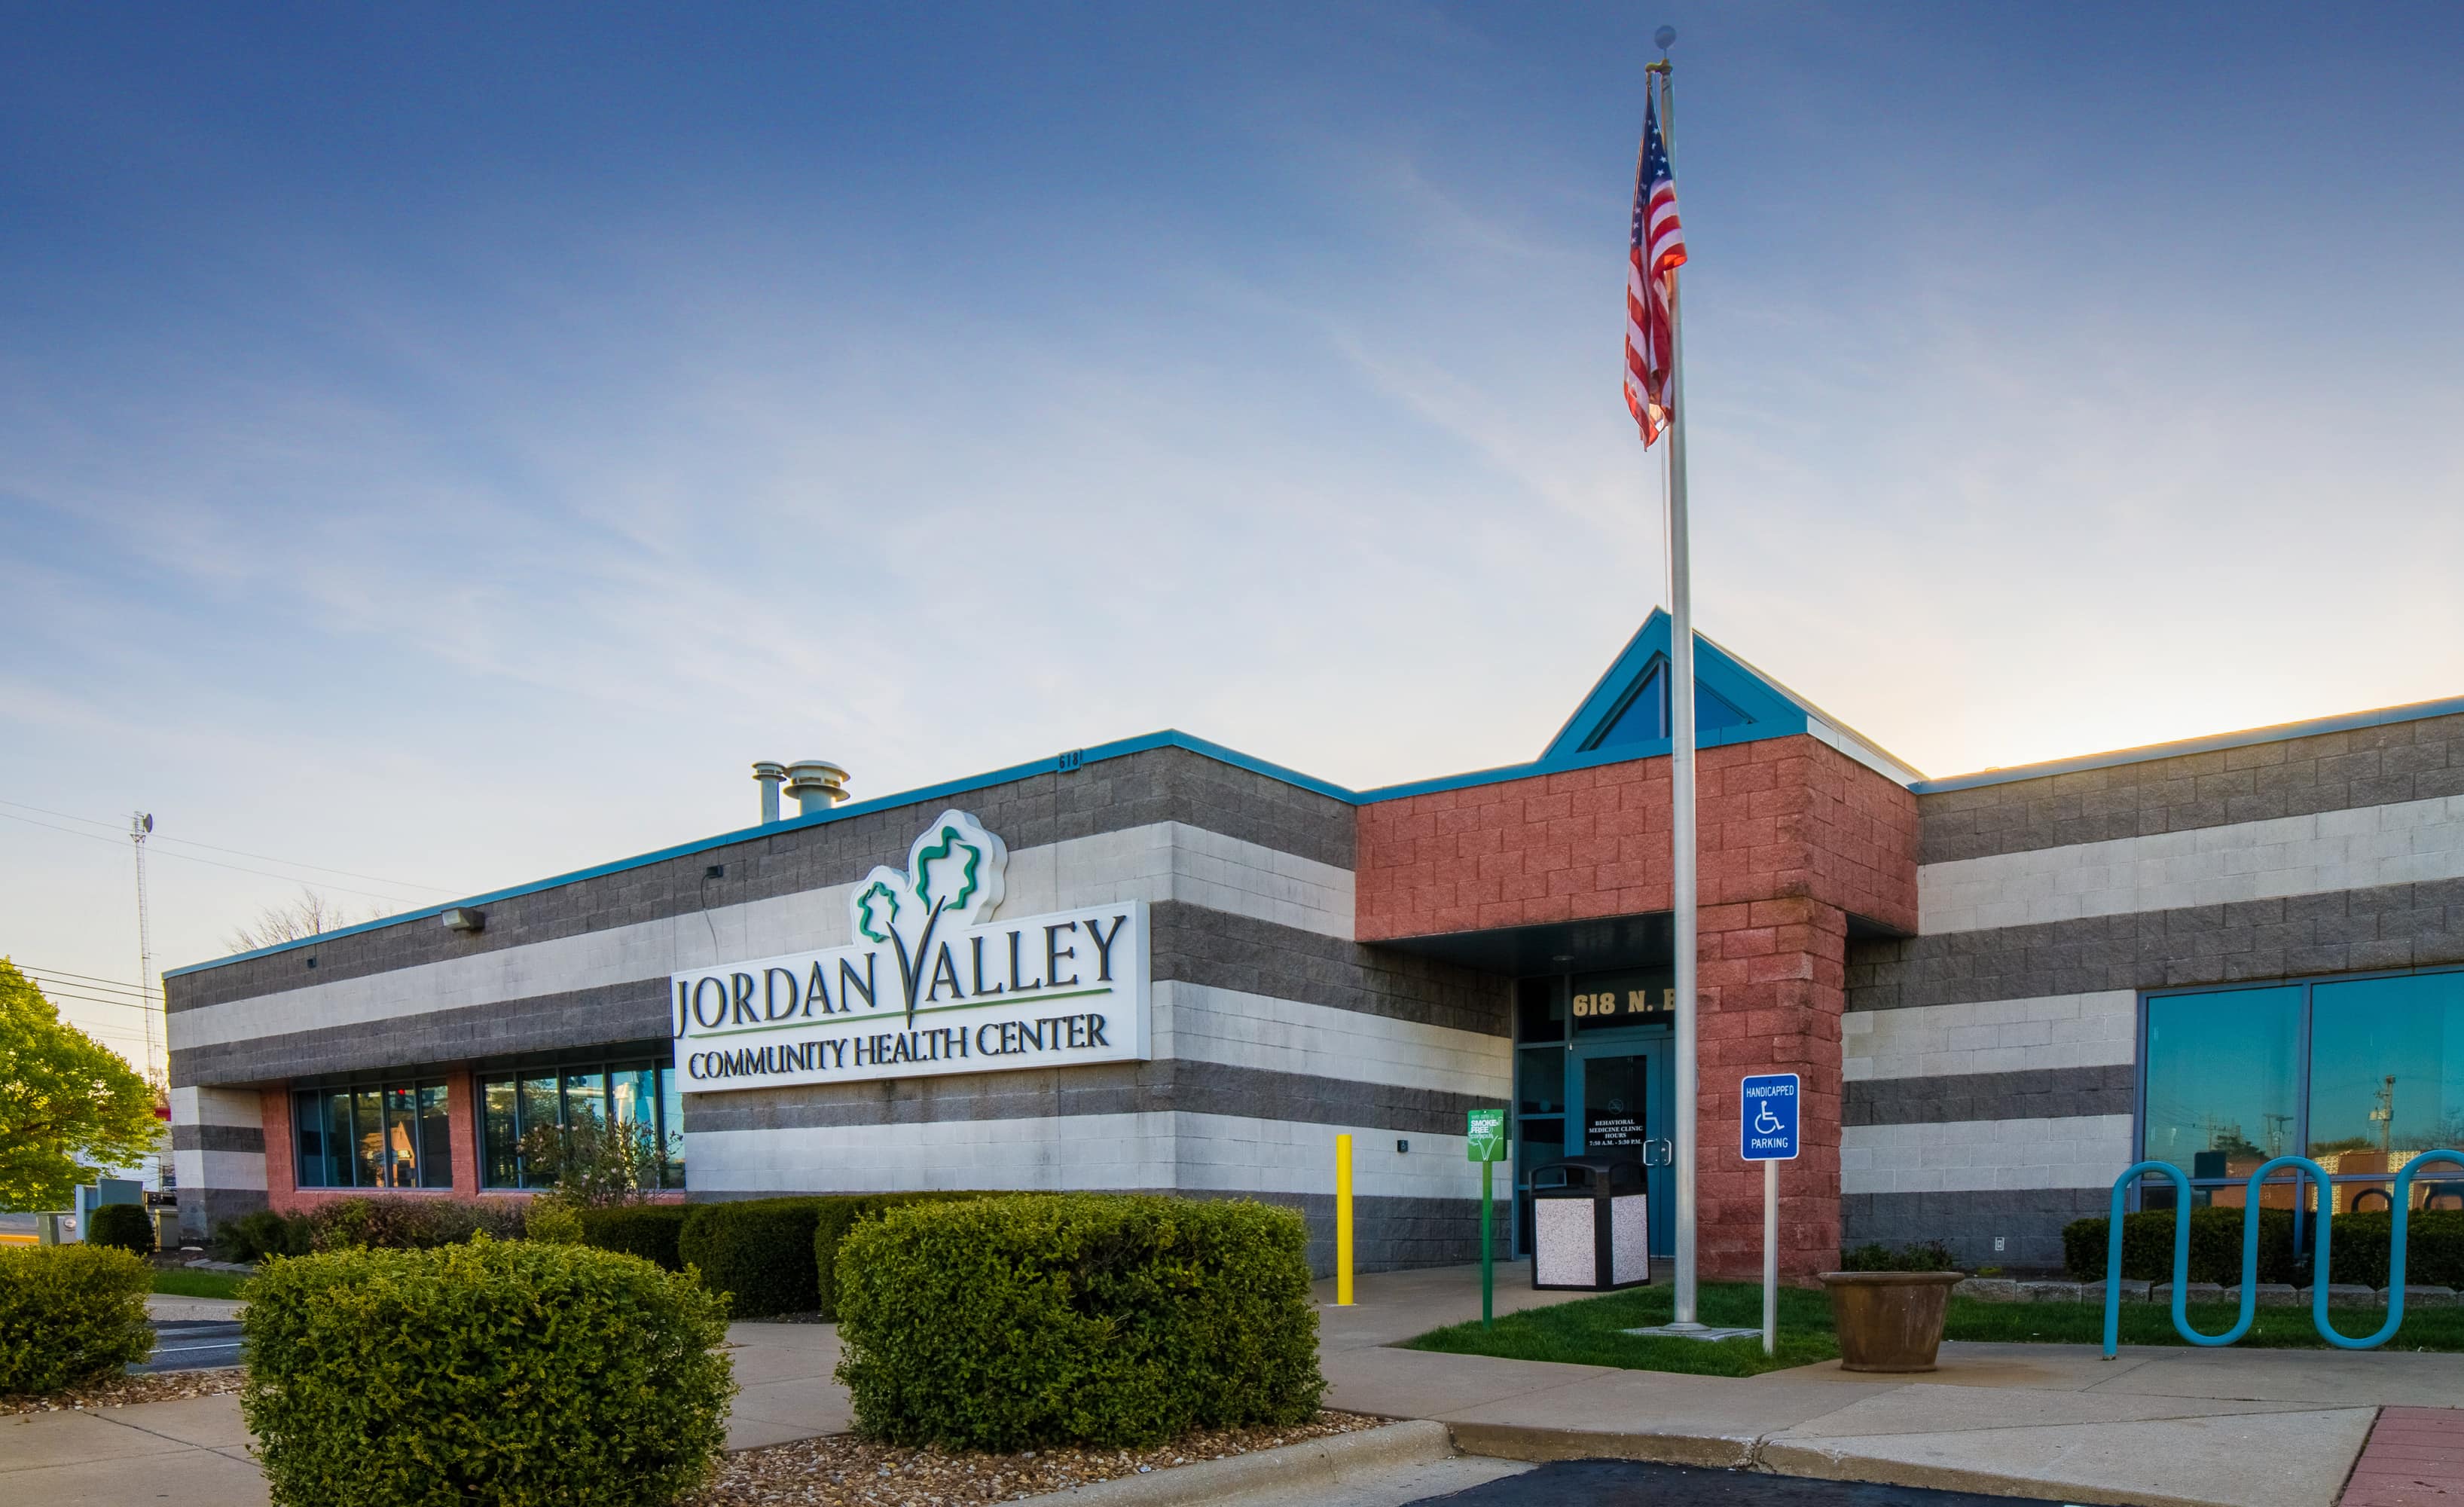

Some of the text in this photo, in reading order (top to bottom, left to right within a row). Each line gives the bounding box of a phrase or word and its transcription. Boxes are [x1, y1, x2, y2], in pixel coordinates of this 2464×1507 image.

[1058, 752, 1078, 769] 618
[673, 894, 1127, 1040] JORDAN VALLEY
[1573, 992, 1616, 1016] 618
[1628, 990, 1653, 1013] N.
[688, 1013, 1110, 1080] COMMUNITY HEALTH CENTER
[1746, 1084, 1794, 1098] HANDICAPPED
[1751, 1137, 1788, 1149] PARKING
